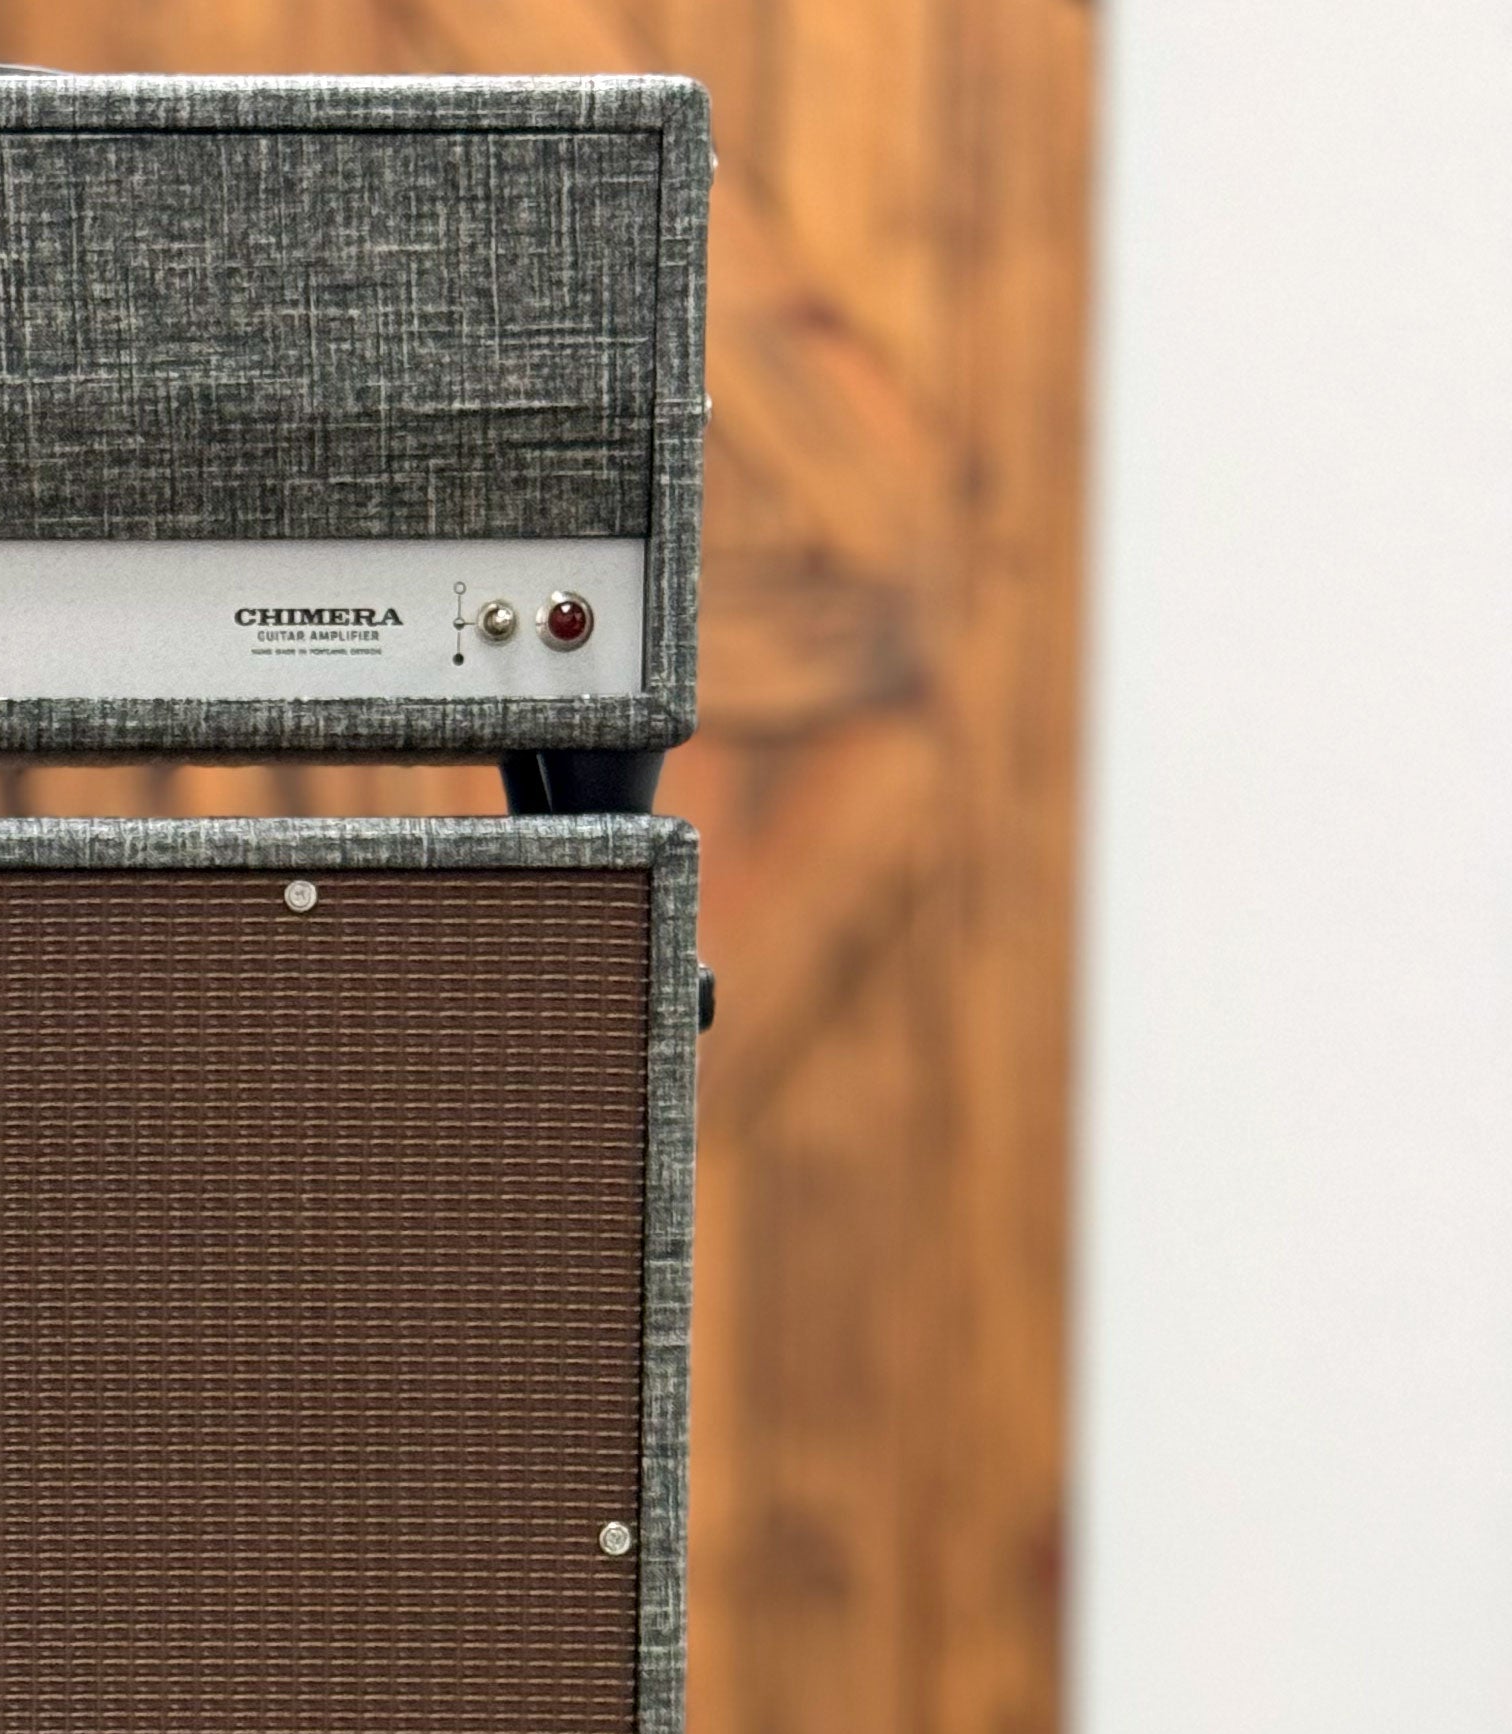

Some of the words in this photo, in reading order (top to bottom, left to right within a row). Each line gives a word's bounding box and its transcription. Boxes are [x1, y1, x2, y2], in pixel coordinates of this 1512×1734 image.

[234, 607, 404, 626] CHIMERA
[257, 630, 305, 642] GUITAR
[310, 630, 380, 642] AMPLIFIER
